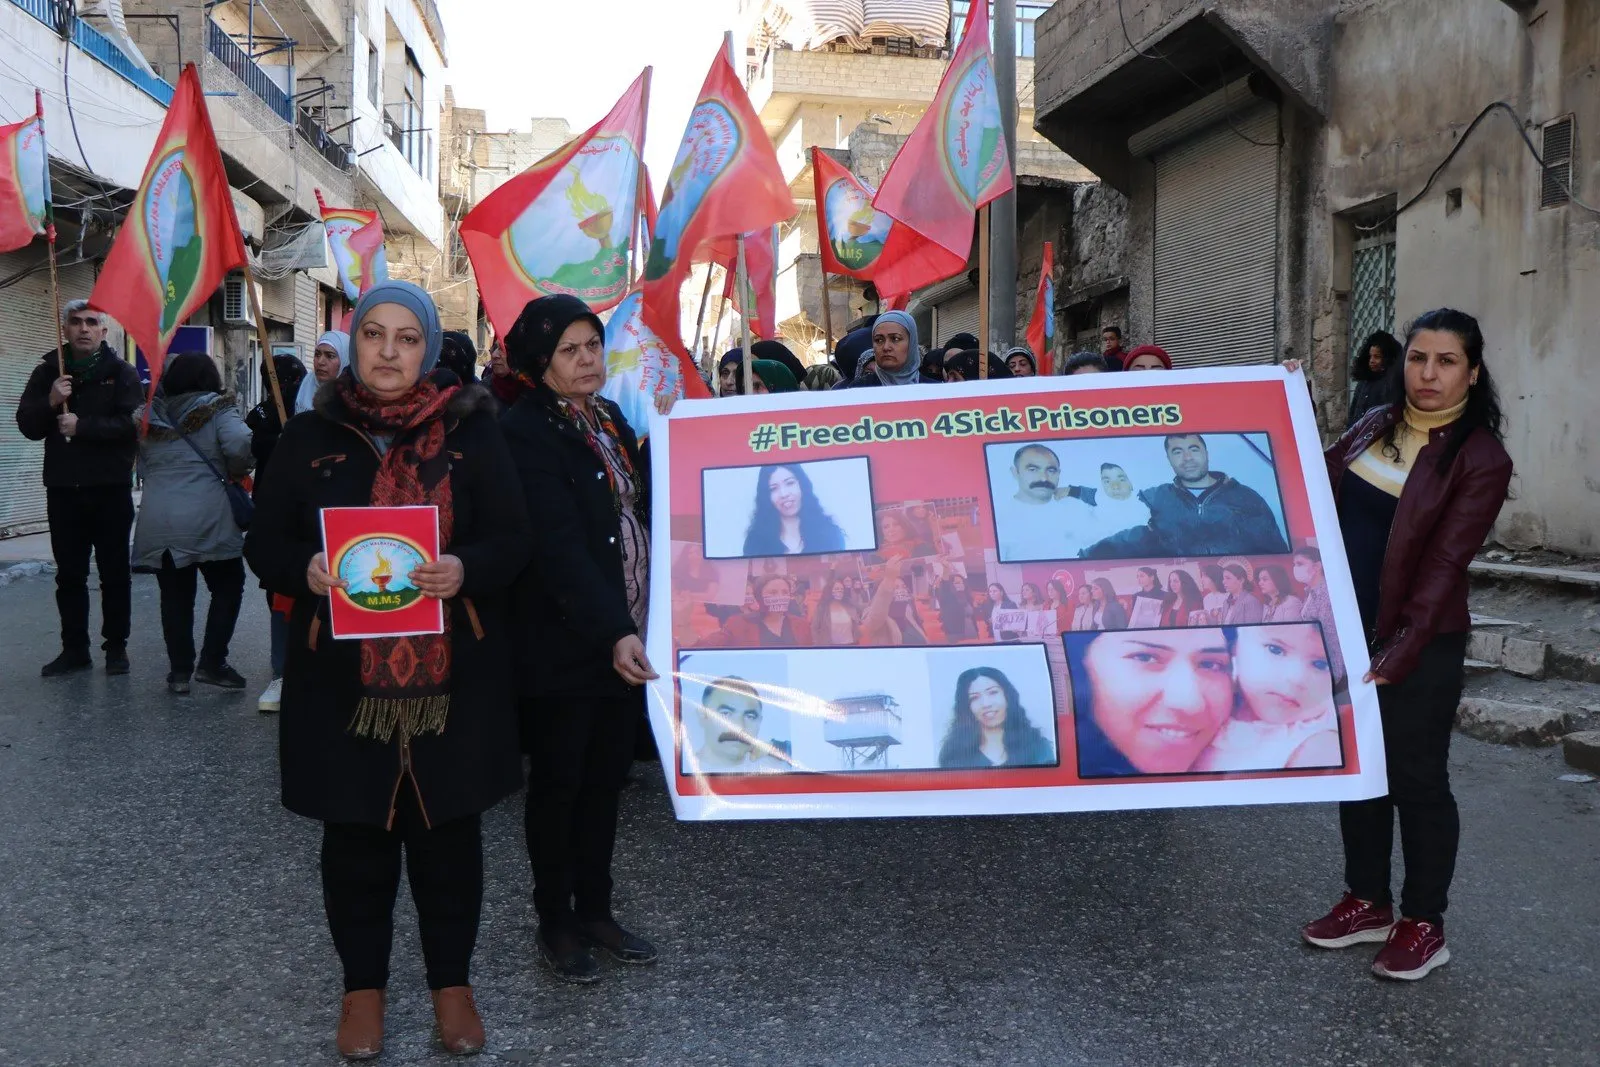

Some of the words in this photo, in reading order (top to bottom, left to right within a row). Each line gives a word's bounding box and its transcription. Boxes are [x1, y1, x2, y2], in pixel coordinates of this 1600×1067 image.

[750, 416, 928, 452] #Freedom
[933, 406, 1023, 437] 4Sick
[1026, 403, 1181, 432] Prisoners
[367, 594, 402, 605] M.M.Ş
